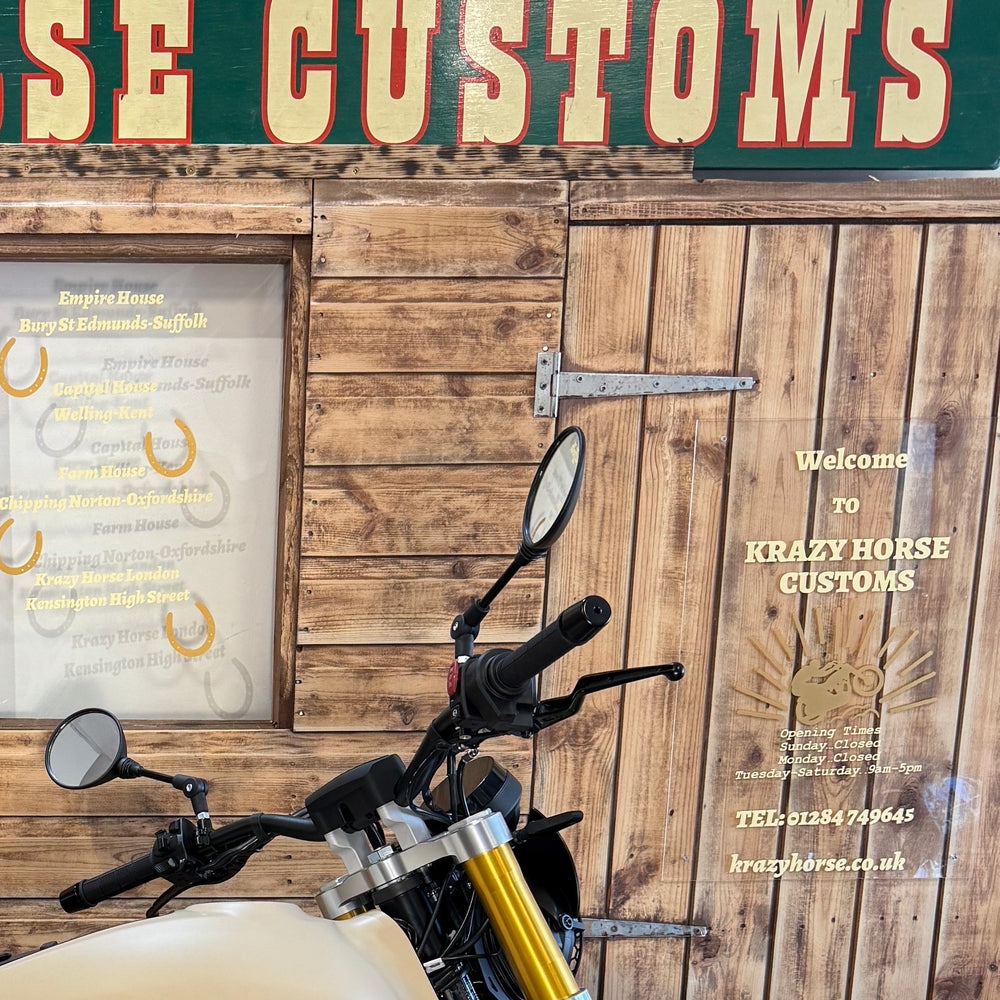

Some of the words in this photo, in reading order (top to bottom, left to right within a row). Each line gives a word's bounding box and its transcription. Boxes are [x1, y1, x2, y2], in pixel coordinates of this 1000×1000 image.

[260, 0, 953, 148] CUSTOMS
[58, 289, 115, 309] Empire
[116, 290, 165, 305] House
[18, 318, 57, 336] Bury
[58, 317, 74, 332] St
[77, 313, 208, 333] Edmunds-Suffolk
[111, 379, 159, 395] House
[795, 447, 909, 471] Welcome
[57, 466, 99, 481] Farm
[100, 464, 146, 479] House
[68, 488, 214, 509] Norton-Oxfordshire
[832, 497, 860, 514] TO
[744, 538, 848, 563] KRAZY
[850, 536, 950, 561] HORSE
[34, 572, 80, 588] Krazy
[81, 569, 125, 585] Horse
[126, 566, 180, 582] London
[779, 569, 915, 594] CUSTOMS
[24, 594, 107, 612] Kensington
[109, 590, 146, 608] High
[147, 588, 191, 604] Street
[780, 728, 836, 740] Opening
[843, 726, 882, 736] Times
[787, 807, 844, 826] 01284
[848, 806, 914, 825] 749645
[729, 851, 906, 878] krazyhorse.co.uk
